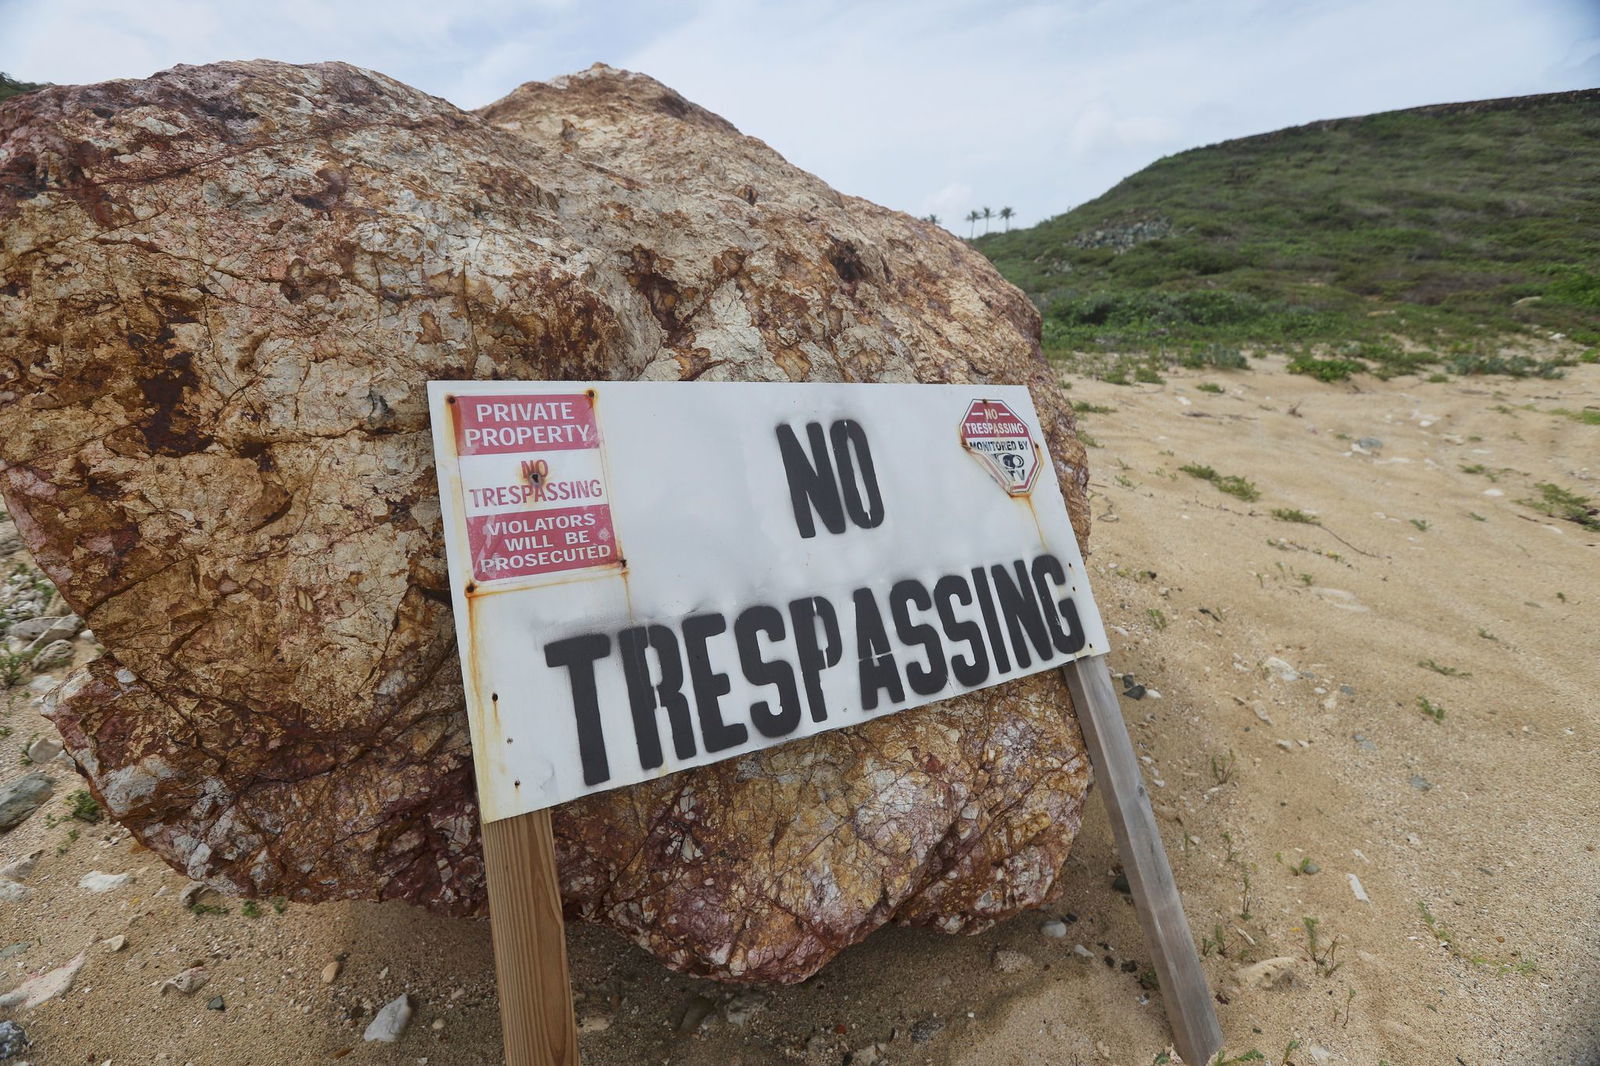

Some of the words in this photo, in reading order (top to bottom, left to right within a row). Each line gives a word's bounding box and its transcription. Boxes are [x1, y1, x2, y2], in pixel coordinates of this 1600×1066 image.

[476, 402, 575, 423] PRIVATE
[984, 408, 998, 420] NO
[464, 424, 590, 448] PROPERTY
[965, 422, 1024, 434] TRESPASSING
[969, 440, 1017, 452] MONITORED
[1018, 440, 1029, 451] BY
[520, 459, 549, 479] NO
[776, 419, 884, 539] NO
[469, 479, 602, 508] TRESPASSING
[487, 513, 596, 536] VIOLATORS
[504, 535, 553, 552] WILL
[565, 530, 590, 544] BE
[480, 545, 611, 573] PROSECUTED
[543, 555, 1086, 786] TRESPASSING
